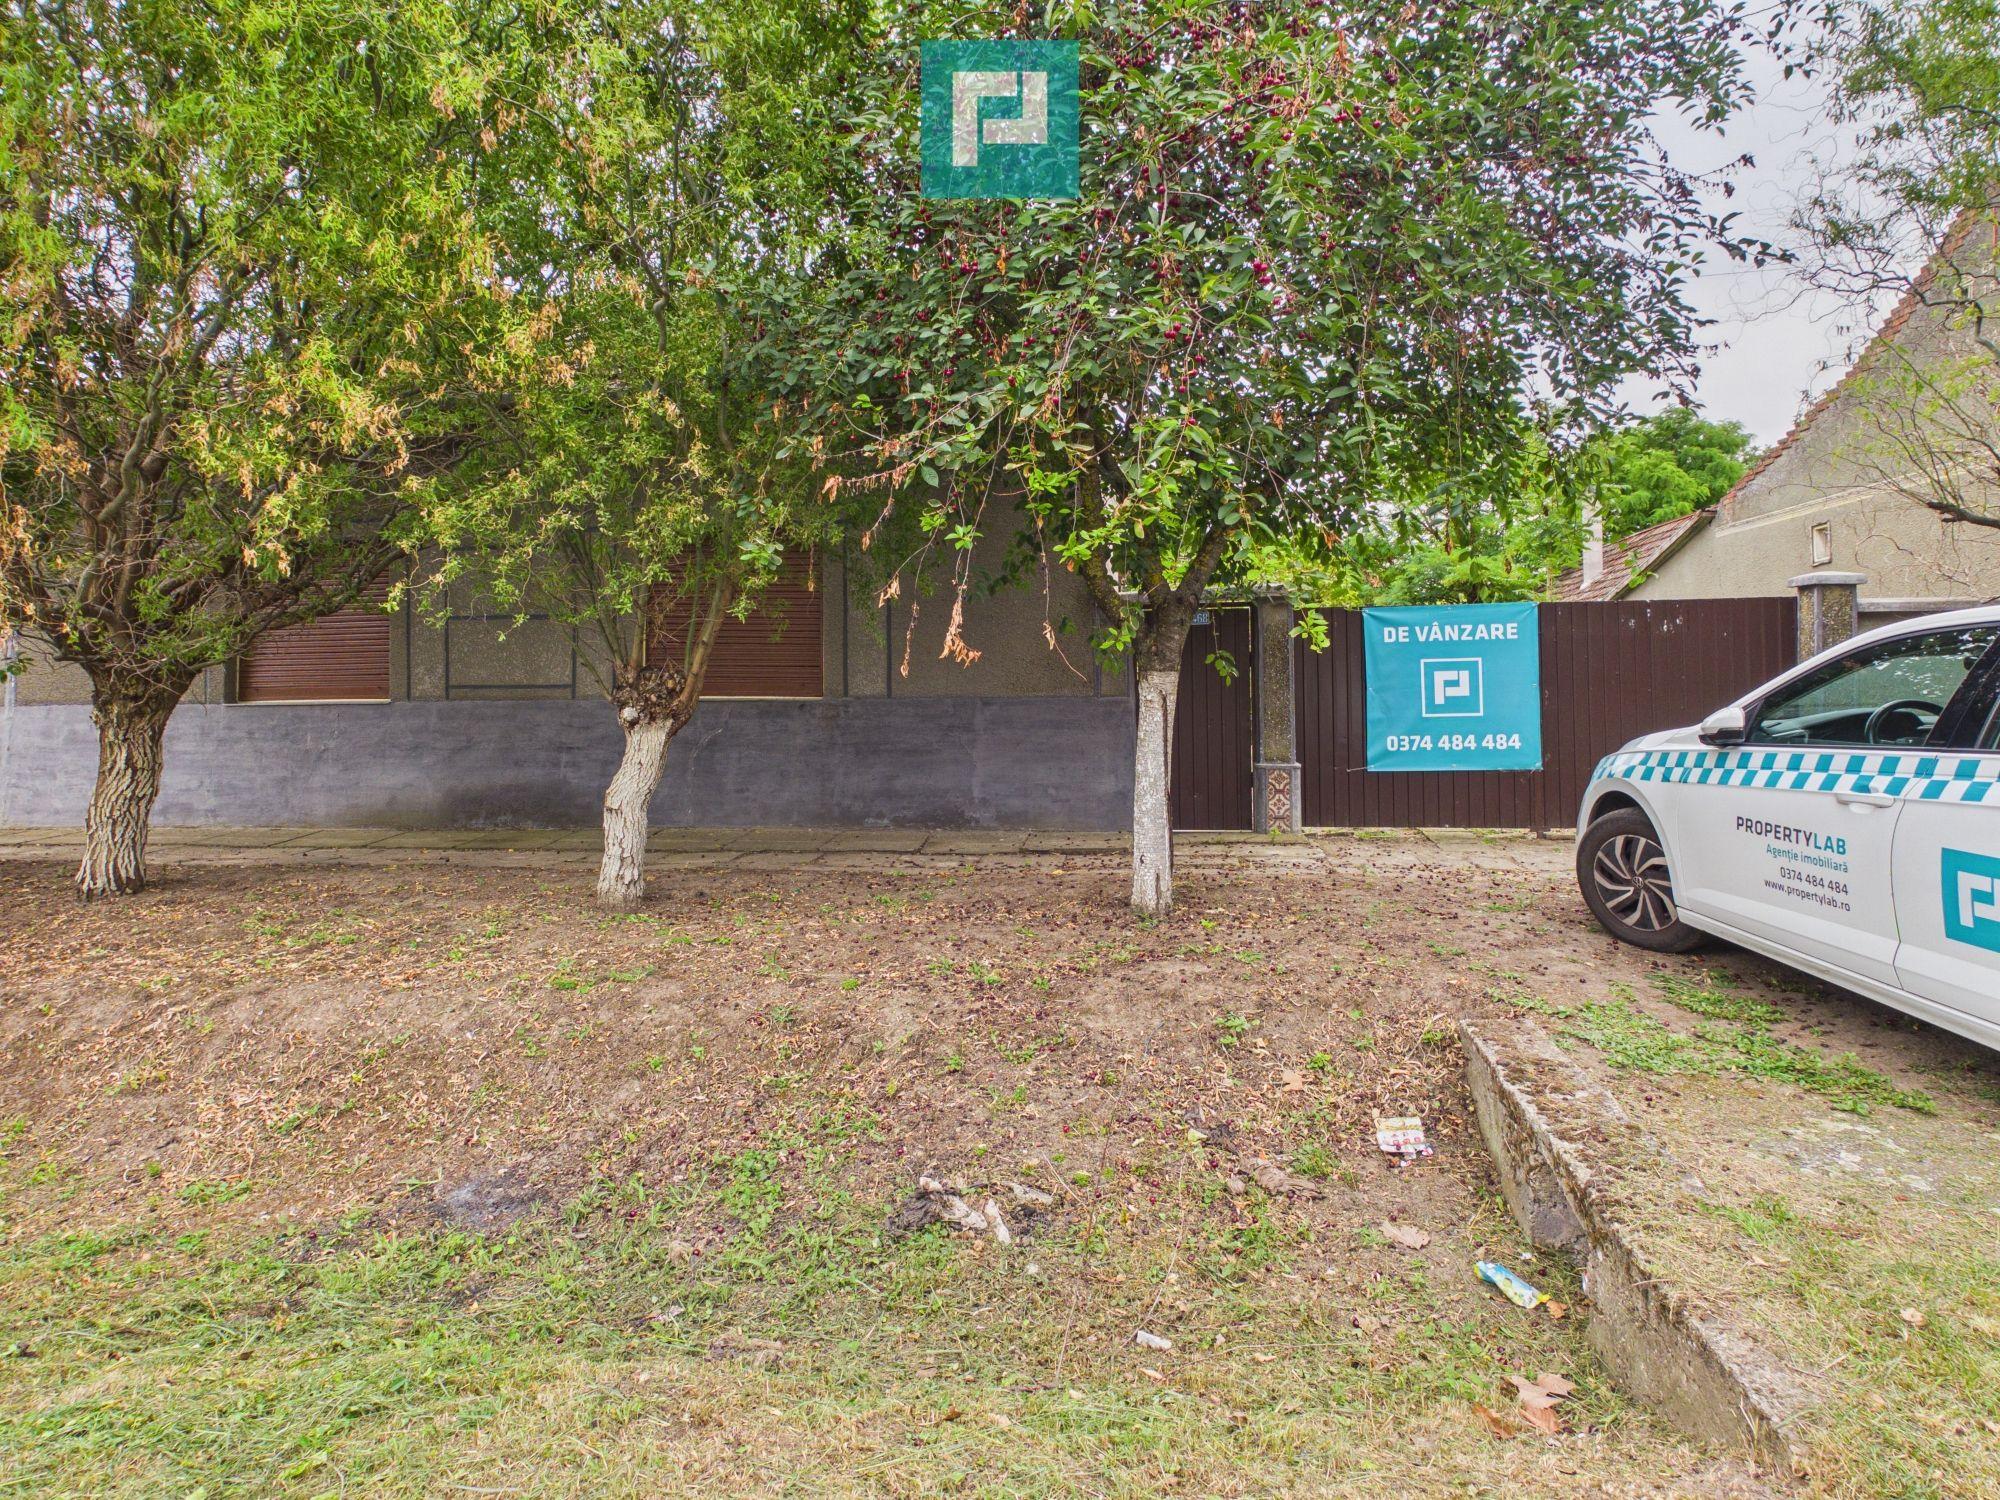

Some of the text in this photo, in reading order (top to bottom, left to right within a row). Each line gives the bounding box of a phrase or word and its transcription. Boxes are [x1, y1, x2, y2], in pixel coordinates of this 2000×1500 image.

[1383, 621, 1518, 643] DE VÂNZARE
[1386, 733, 1522, 752] 0374 484 484
[1736, 816, 1847, 856] PROPERTYLAB
[1800, 851, 1848, 873] imobiliară
[1780, 867, 1849, 896] 0374 484 484
[1764, 879, 1851, 912] www.propertylab.ro
